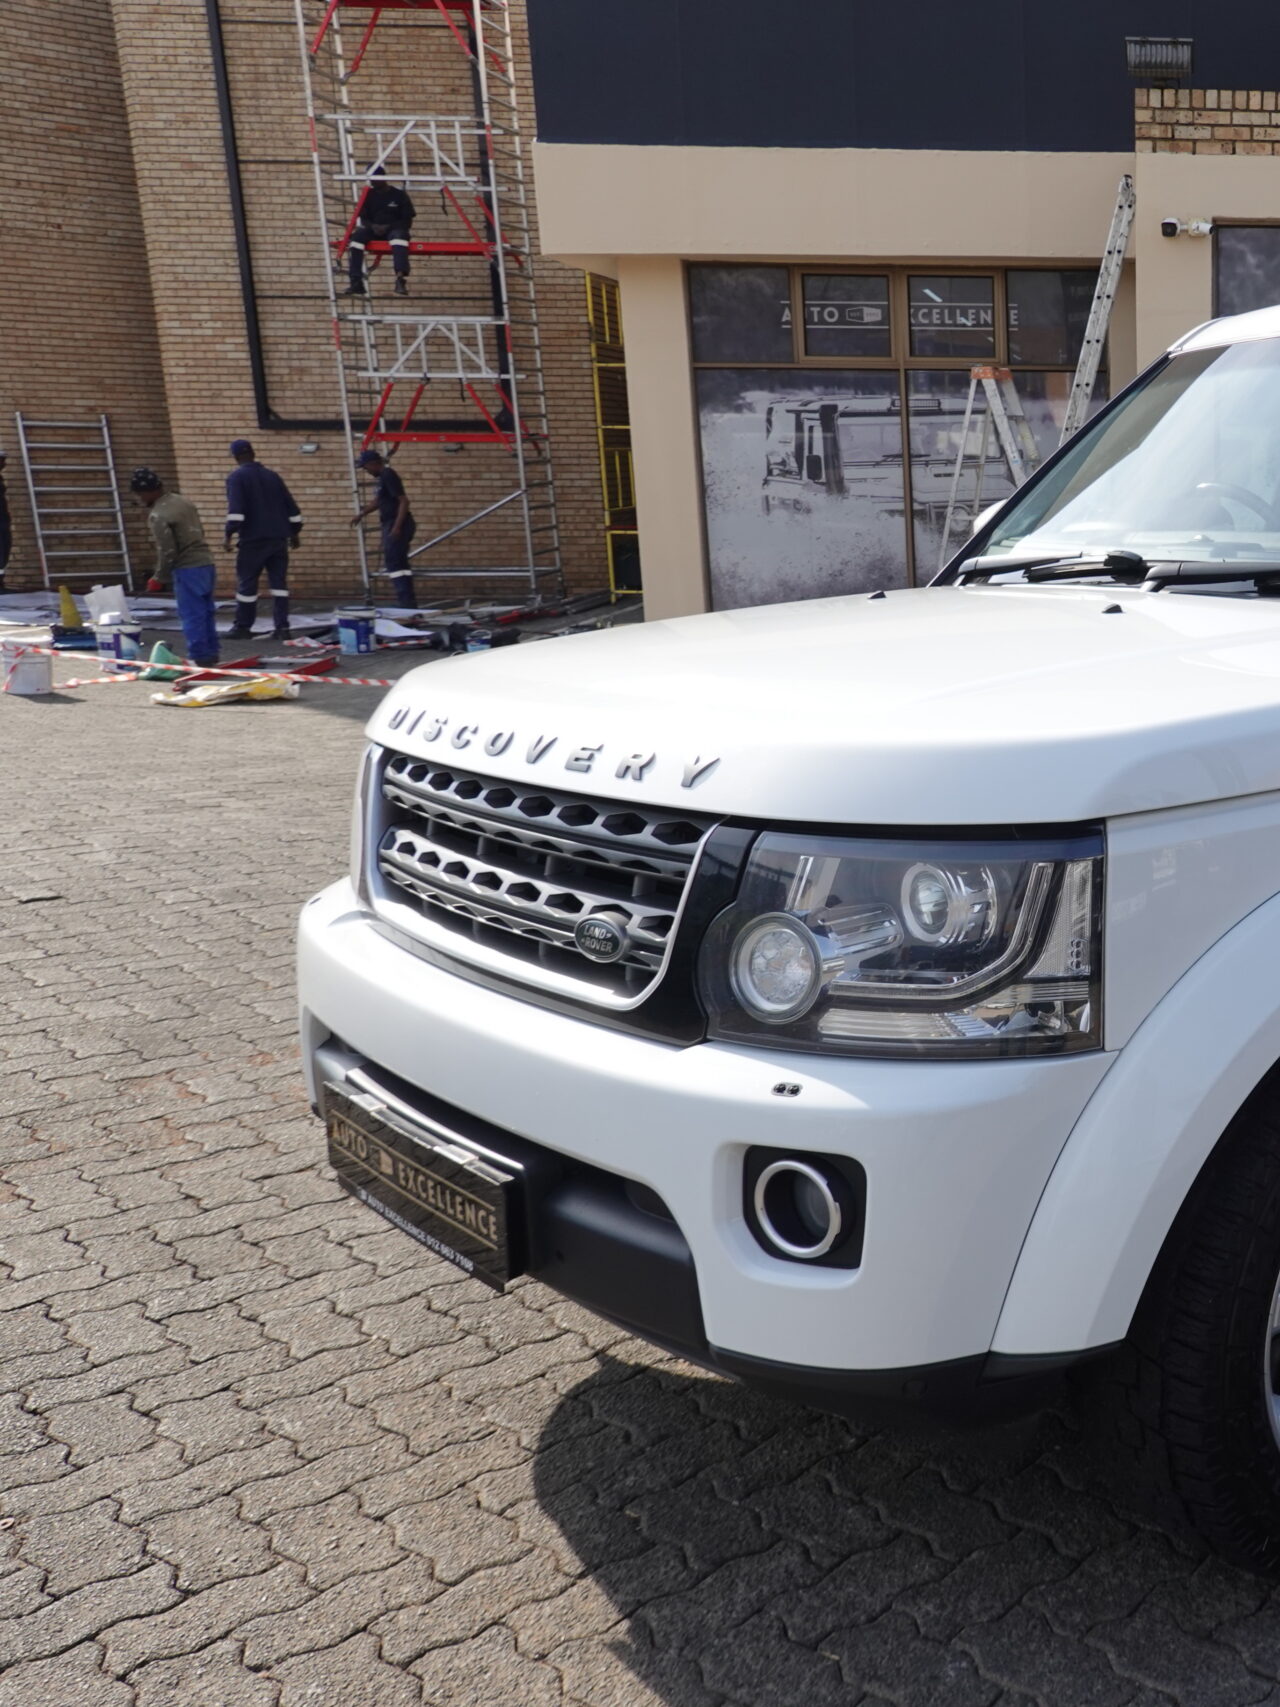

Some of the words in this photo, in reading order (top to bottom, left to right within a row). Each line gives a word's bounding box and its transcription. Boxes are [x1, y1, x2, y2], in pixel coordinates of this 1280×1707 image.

[781, 306, 839, 323] ATO
[388, 706, 721, 788] DISCOVERY
[584, 924, 607, 940] LAND
[585, 937, 613, 953] ROVER
[331, 1119, 368, 1160] AUTO
[398, 1163, 499, 1242] EXCELLENCE
